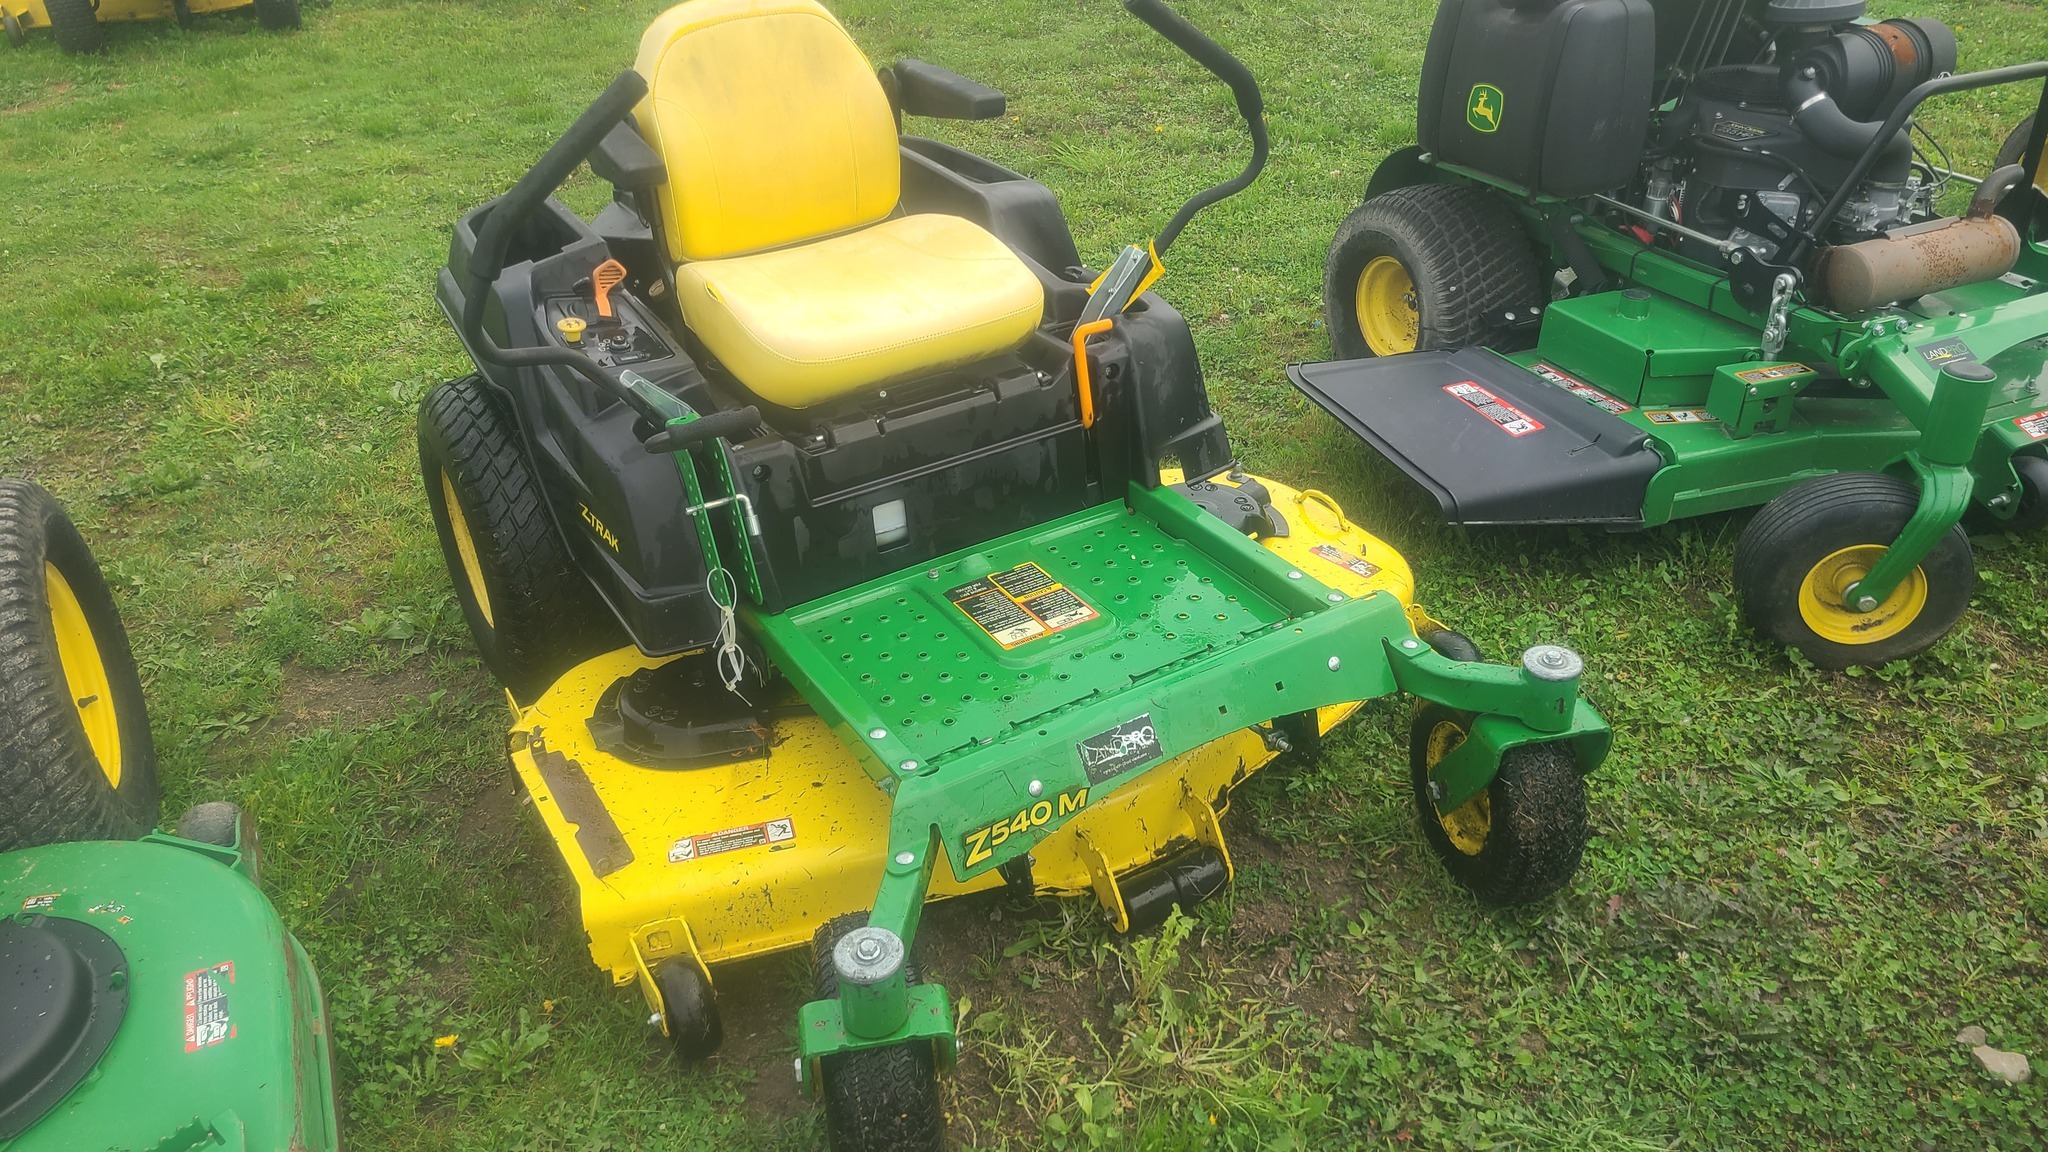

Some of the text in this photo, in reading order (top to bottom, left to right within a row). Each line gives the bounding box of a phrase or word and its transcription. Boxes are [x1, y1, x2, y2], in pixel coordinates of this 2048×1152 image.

[1923, 342, 1967, 360] LANDPRO
[718, 826, 749, 836] DANGER
[965, 788, 1088, 868] Z540 M
